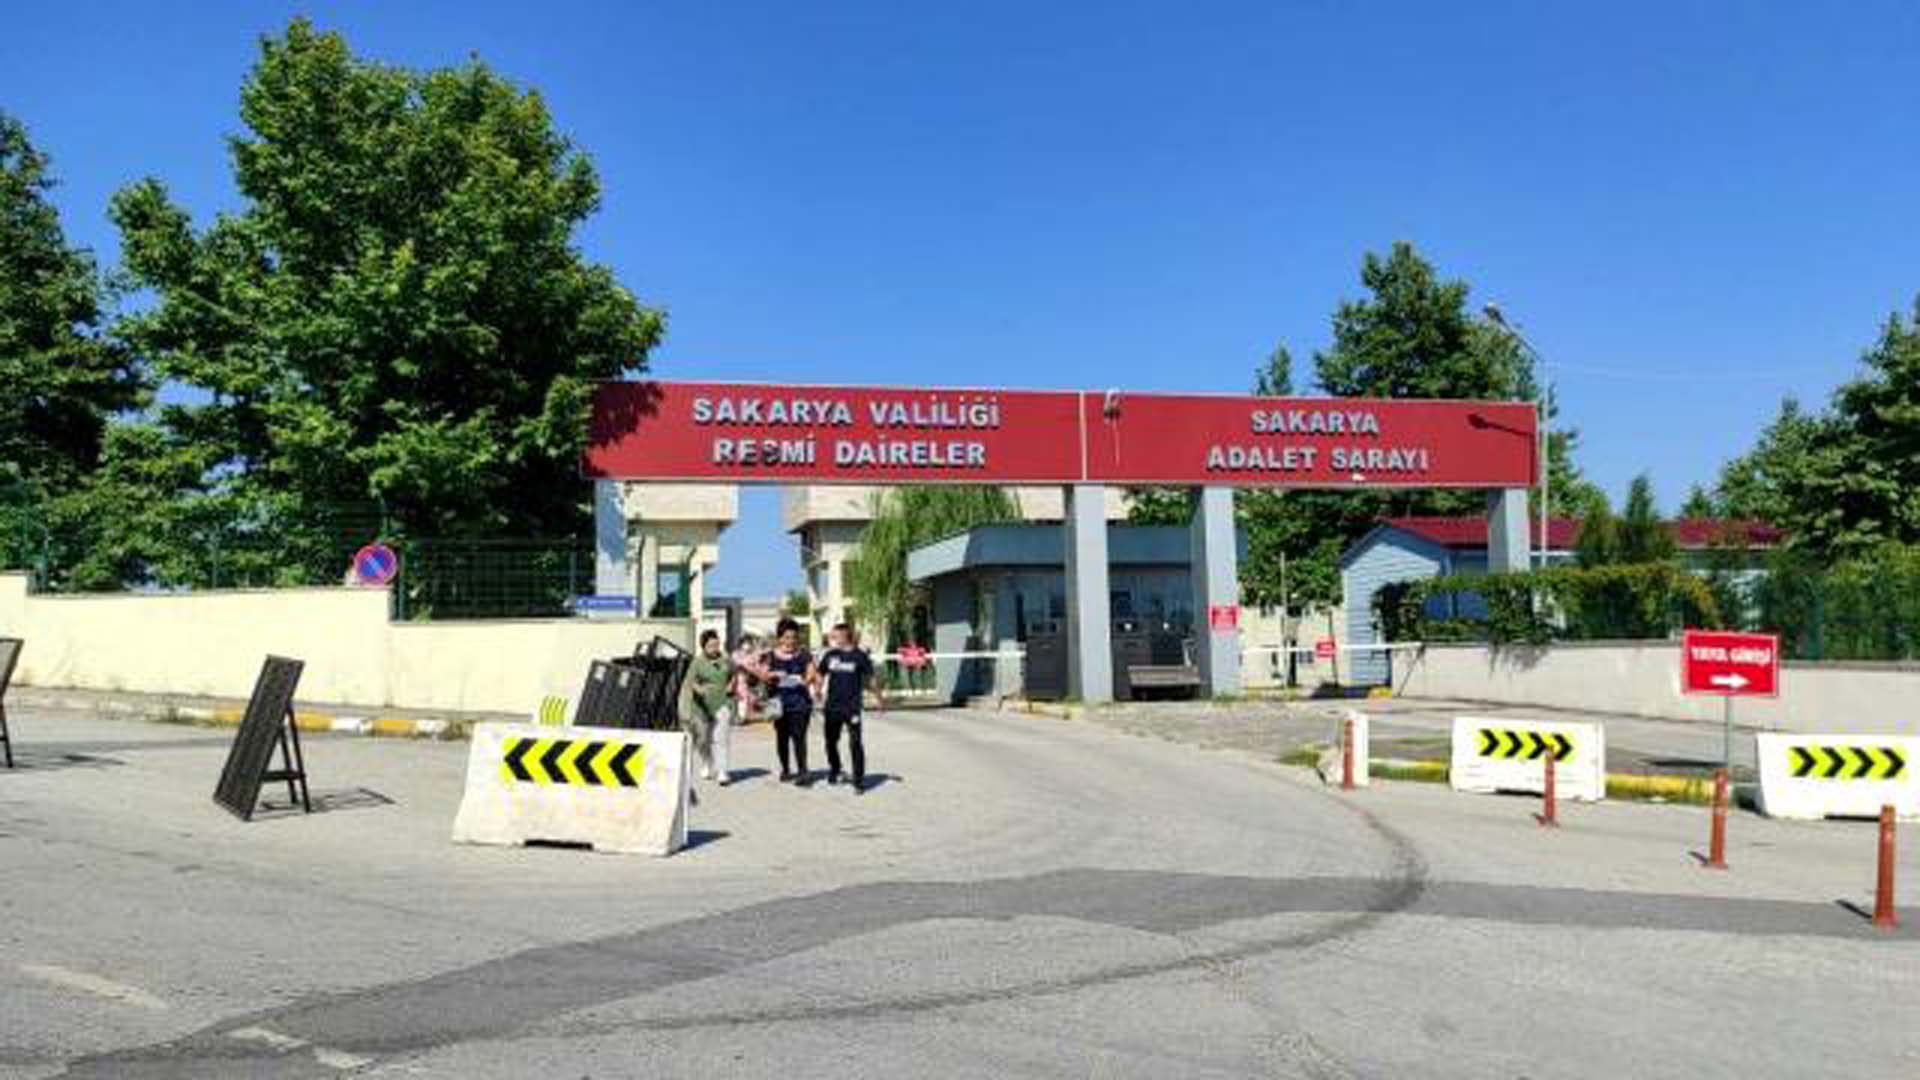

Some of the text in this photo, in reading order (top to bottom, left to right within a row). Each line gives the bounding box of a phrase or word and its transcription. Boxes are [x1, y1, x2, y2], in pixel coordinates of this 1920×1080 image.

[693, 395, 1000, 427] SAKARYA VALİLİĞİ
[1251, 410, 1380, 434] SAKARYA
[713, 433, 986, 467] RESMİ DAİRELER
[1207, 445, 1429, 471] ADALET SARAYI
